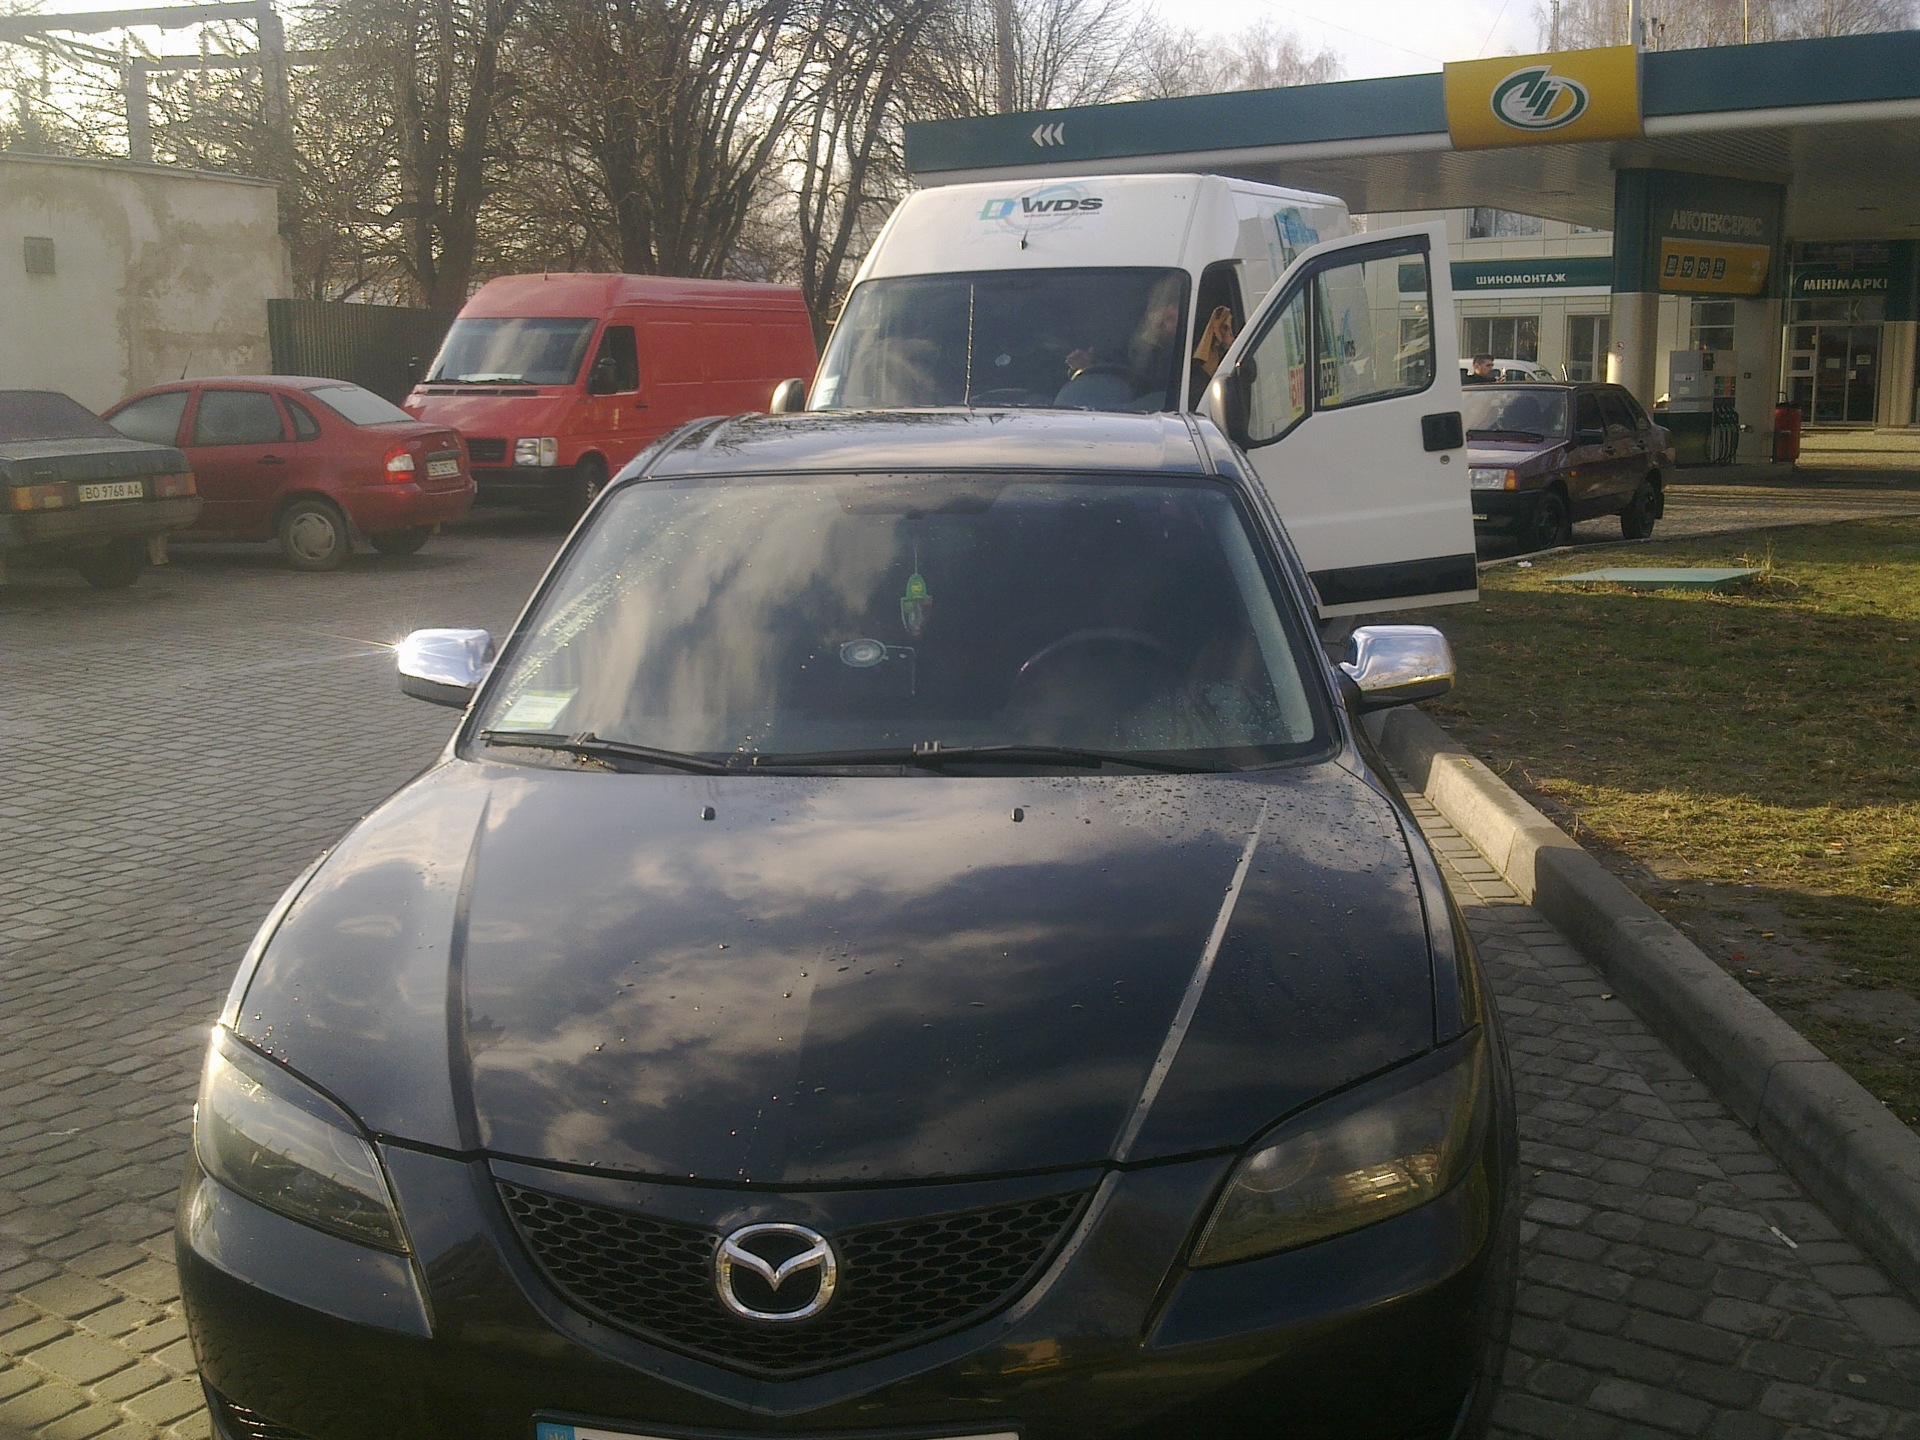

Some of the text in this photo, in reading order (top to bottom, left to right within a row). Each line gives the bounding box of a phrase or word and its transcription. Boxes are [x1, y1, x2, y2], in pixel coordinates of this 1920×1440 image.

[1021, 197, 1103, 213] WDS
[1475, 273, 1566, 285] ШИНОМОНТАЖ
[85, 483, 141, 499] BO 9768 AA
